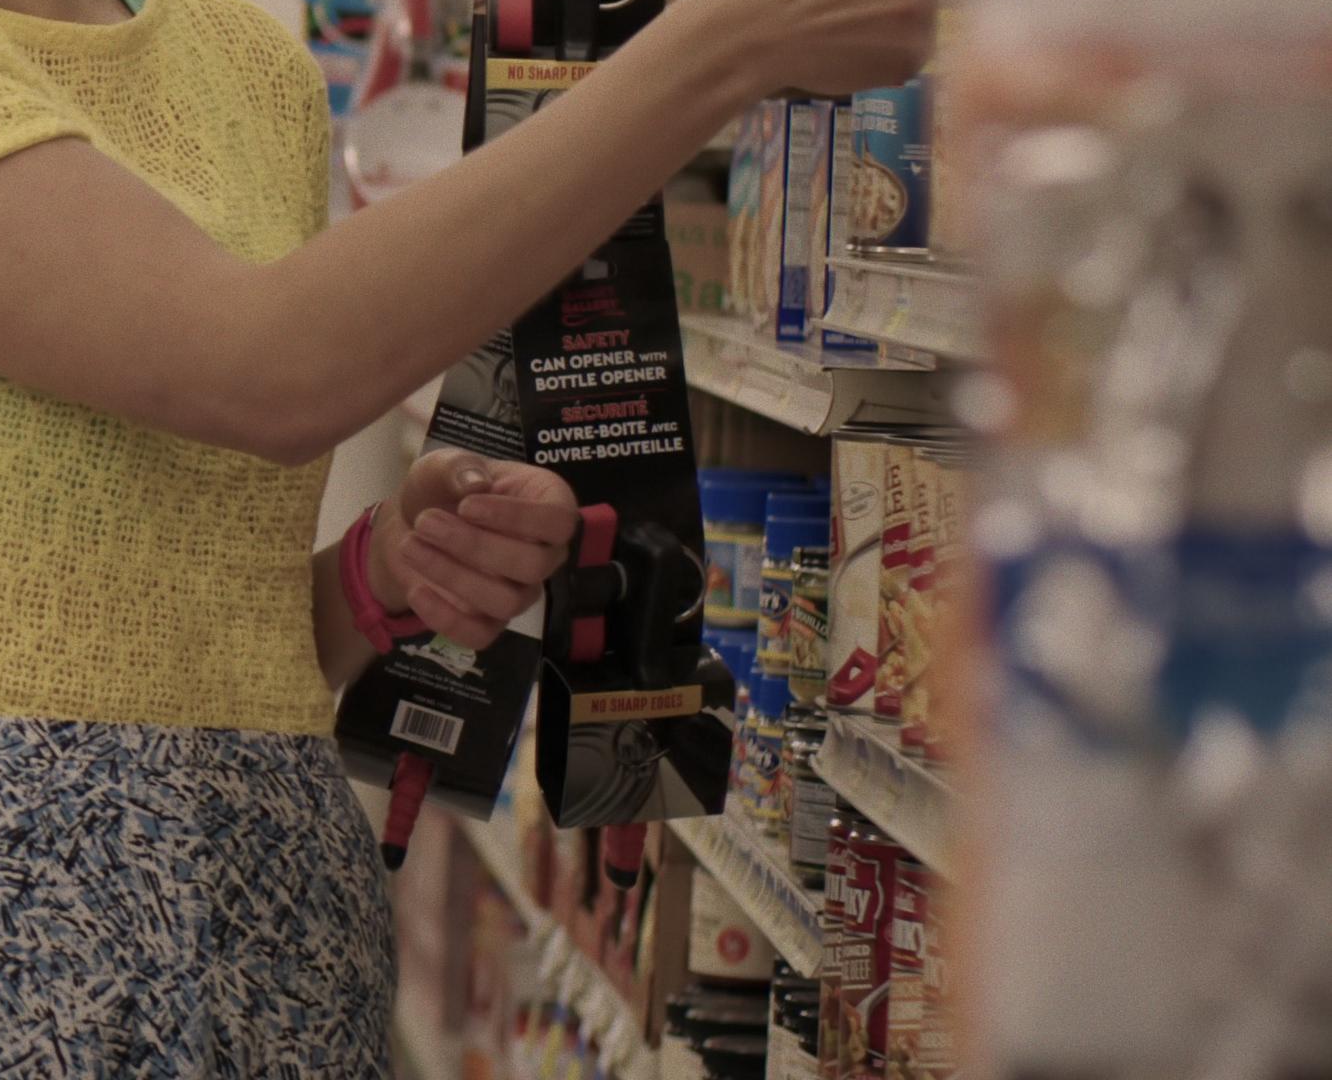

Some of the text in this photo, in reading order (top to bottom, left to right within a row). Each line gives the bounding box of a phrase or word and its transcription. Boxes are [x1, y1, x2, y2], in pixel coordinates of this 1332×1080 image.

[507, 64, 524, 80] NO
[528, 64, 568, 81] SHARP
[561, 329, 630, 351] SAFETY
[530, 350, 667, 374] CAN OPENER WITH
[535, 366, 667, 392] BOTTLE OPENER
[561, 394, 649, 422] SÉCURITÉ
[537, 420, 647, 444] OUVRE-BOITE
[651, 421, 678, 434] AVEC
[534, 437, 685, 464] OUVRE-BOUTEILLE
[591, 693, 684, 713] NO SHARP EDGES
